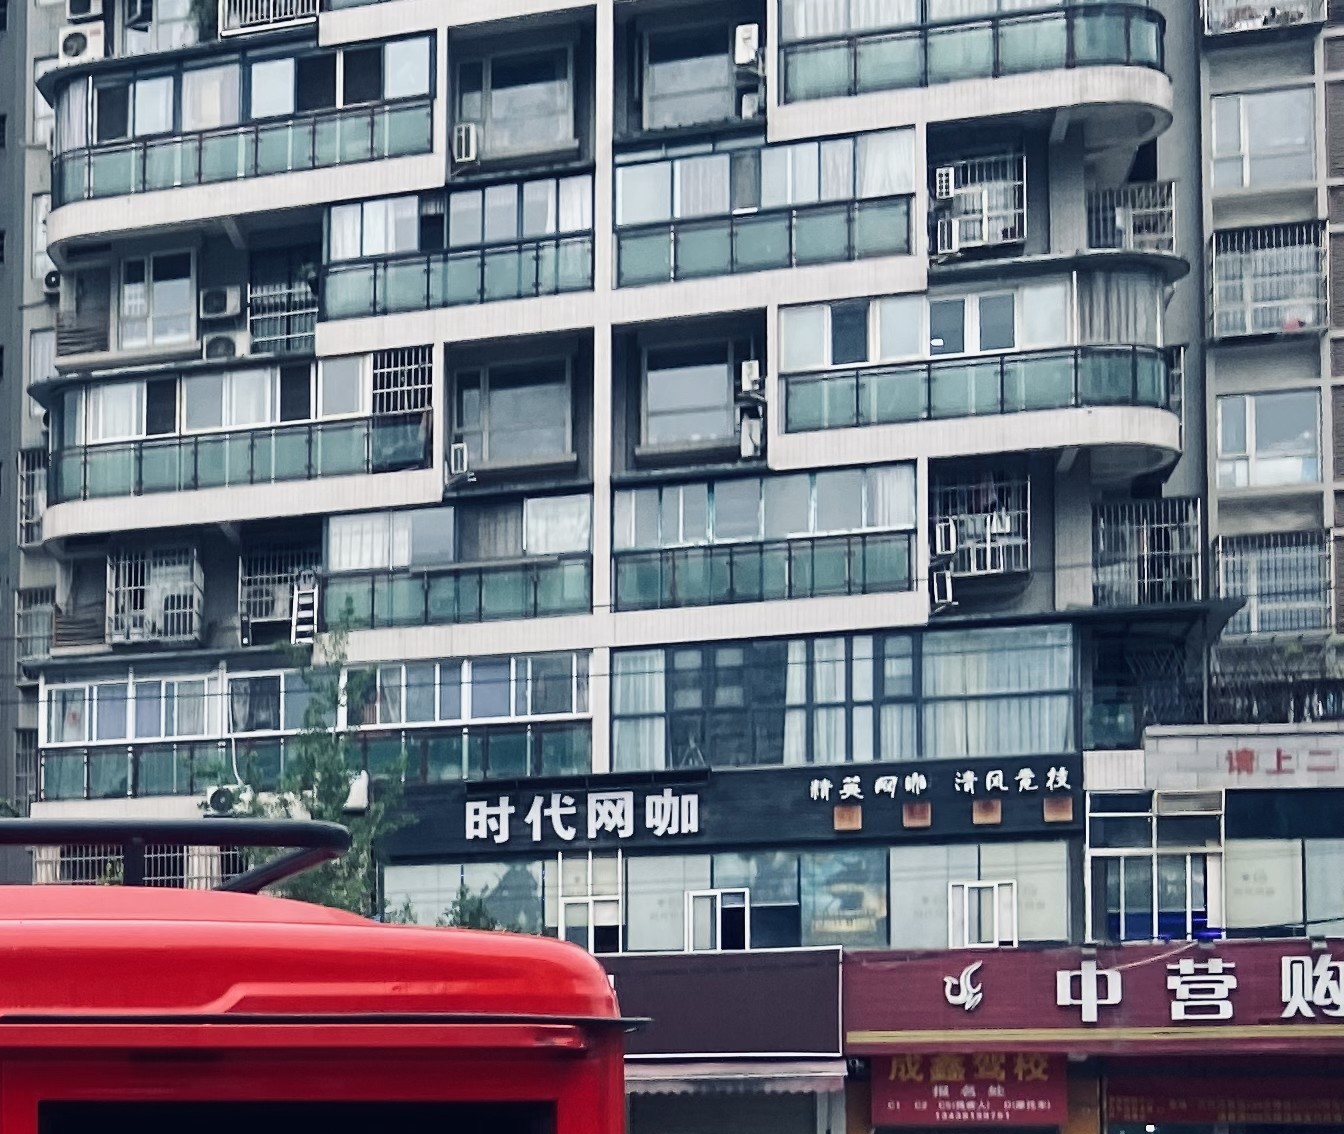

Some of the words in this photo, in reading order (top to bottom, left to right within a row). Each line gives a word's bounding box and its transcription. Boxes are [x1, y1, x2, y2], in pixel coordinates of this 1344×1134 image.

[809, 771, 928, 801] 精英网咖
[954, 766, 1072, 795] 清风竞技
[465, 788, 700, 844] 时代网咖
[1055, 953, 1344, 1023] 中营购
